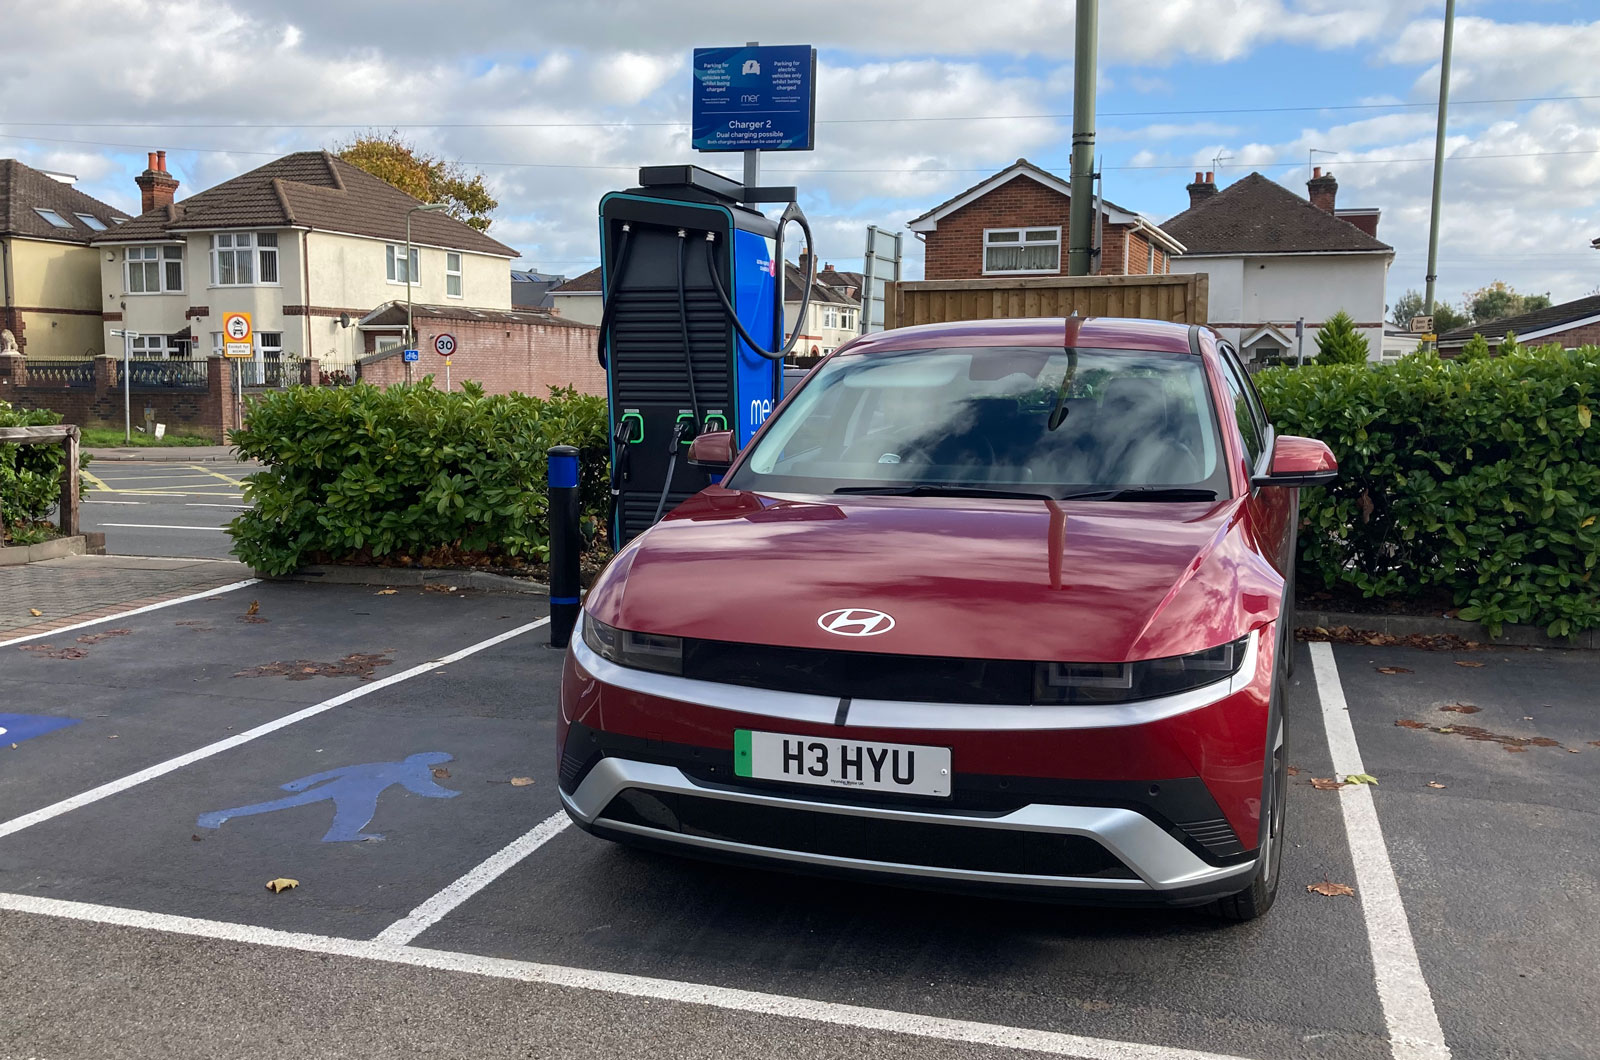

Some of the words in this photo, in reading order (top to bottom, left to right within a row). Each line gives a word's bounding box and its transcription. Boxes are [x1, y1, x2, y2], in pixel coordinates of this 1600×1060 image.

[741, 94, 760, 102] mer
[729, 120, 764, 130] Charger
[438, 340, 452, 350] 30
[783, 740, 829, 777] H3
[841, 745, 914, 784] HYU
